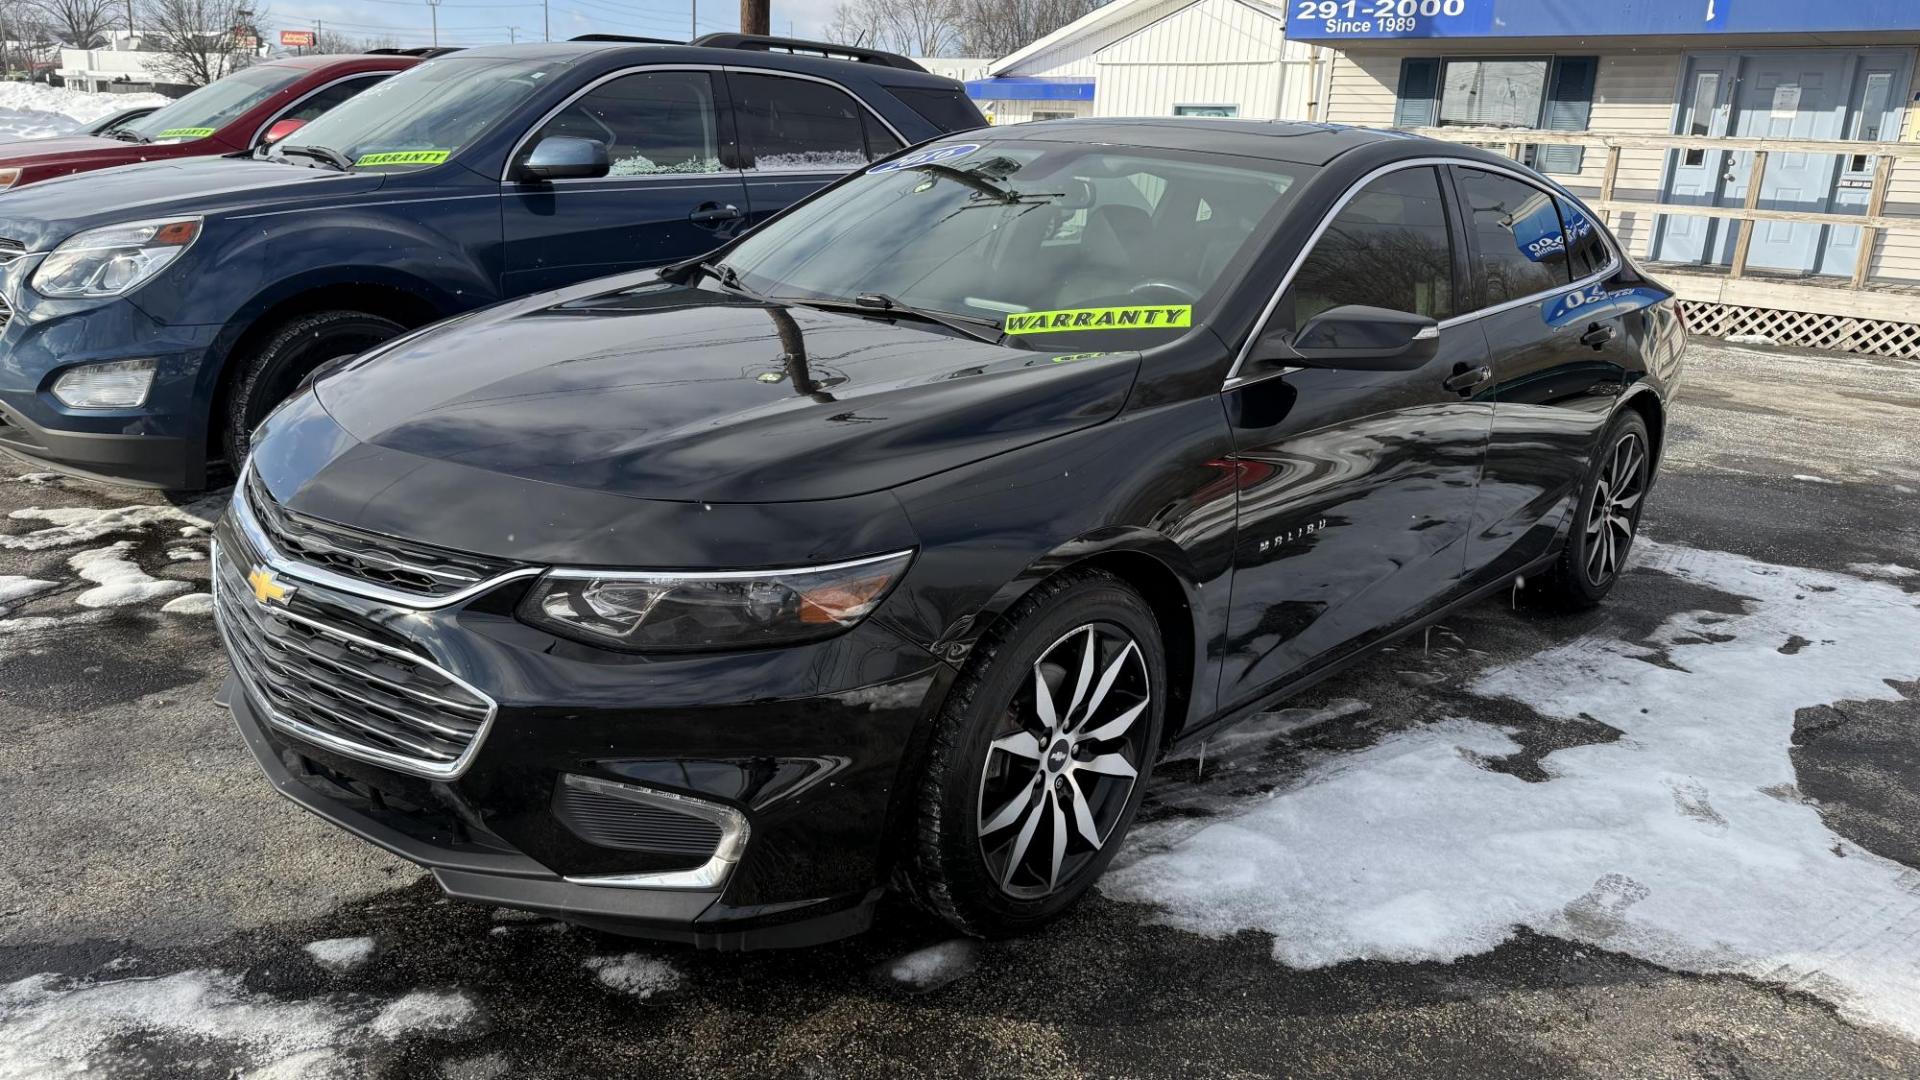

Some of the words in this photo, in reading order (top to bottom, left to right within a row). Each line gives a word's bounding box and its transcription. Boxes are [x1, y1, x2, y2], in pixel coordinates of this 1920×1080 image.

[1296, 0, 1465, 19] 291-2000
[1325, 18, 1371, 33] Since
[1377, 17, 1416, 32] 1989
[357, 152, 447, 165] WARRANTY
[1007, 309, 1187, 330] WARRANTY
[1260, 518, 1326, 552] MALIBU
